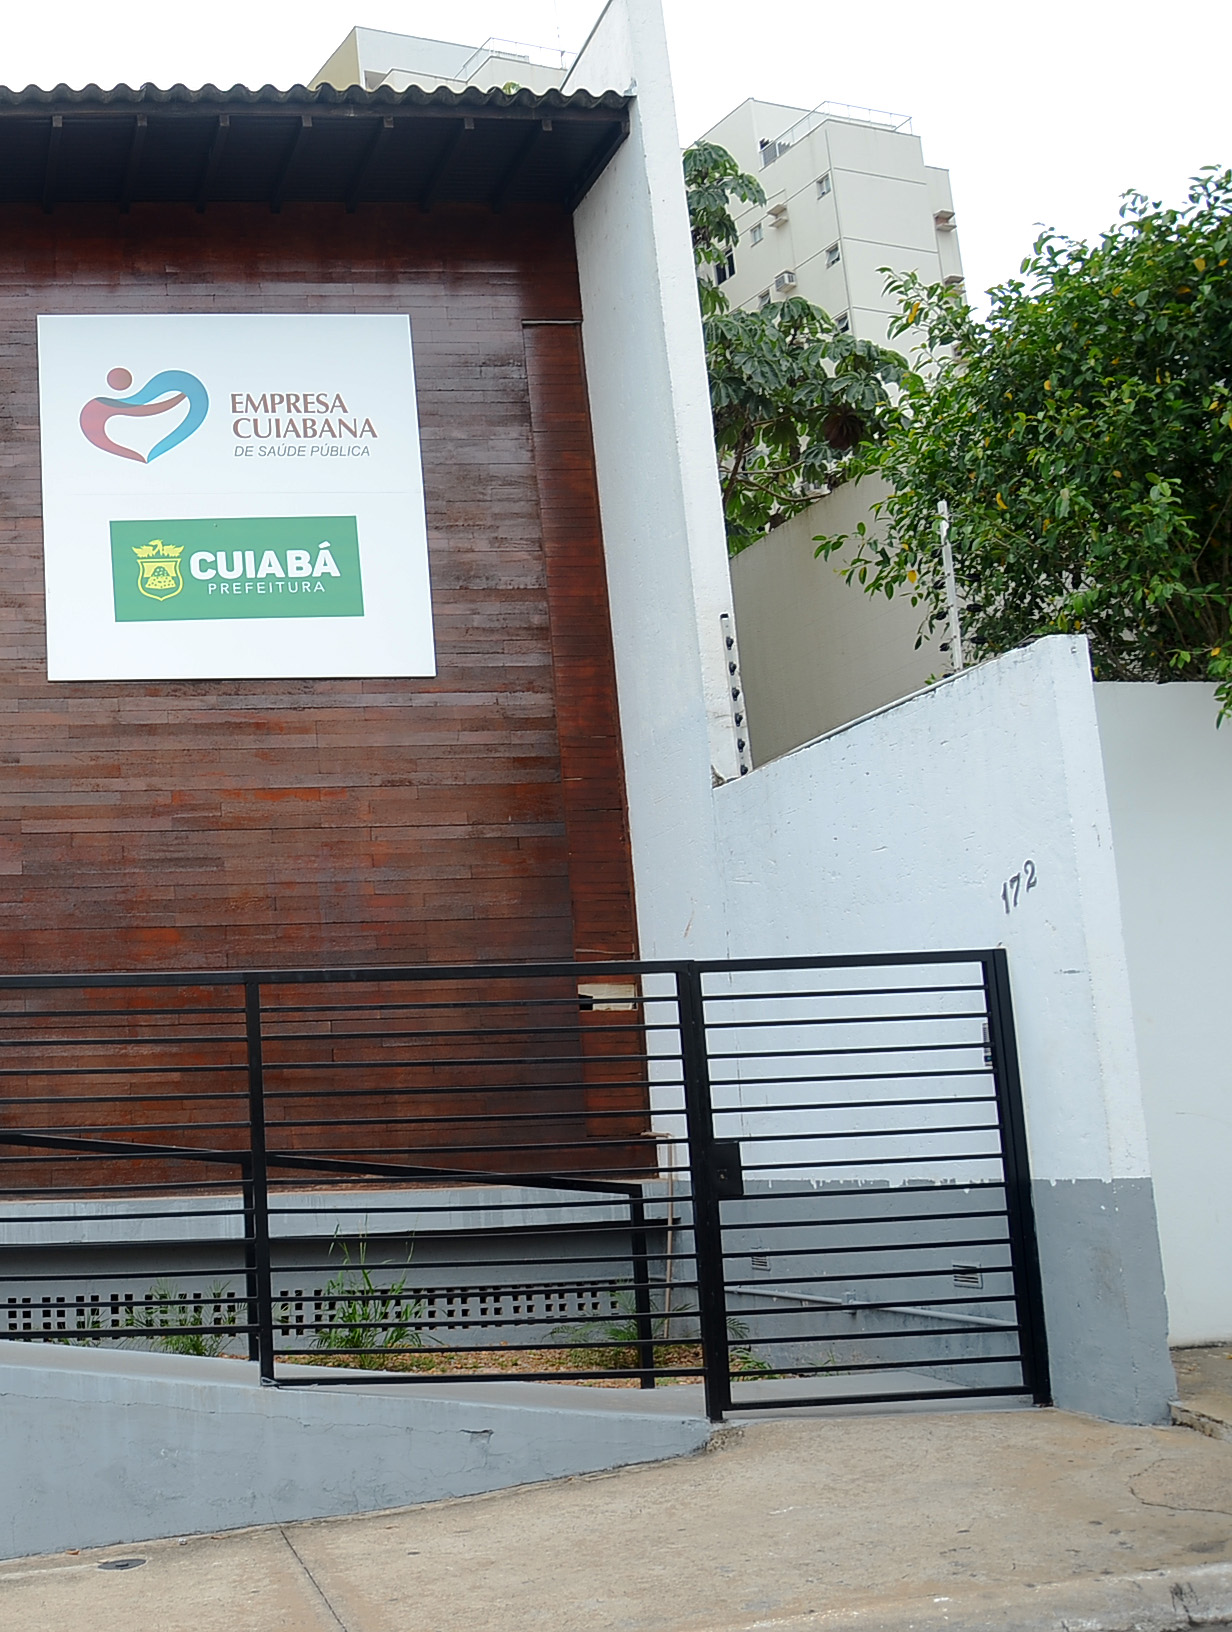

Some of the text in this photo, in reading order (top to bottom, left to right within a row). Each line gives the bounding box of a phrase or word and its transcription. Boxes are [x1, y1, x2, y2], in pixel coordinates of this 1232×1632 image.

[230, 393, 349, 414] EMPRESA
[232, 417, 378, 439] CUIABANA
[234, 443, 370, 457] DE SAÚDE PÚBLICA
[189, 540, 341, 580] CUIABÁ
[207, 581, 326, 595] PREFEITURA
[1001, 859, 1038, 915] 172
